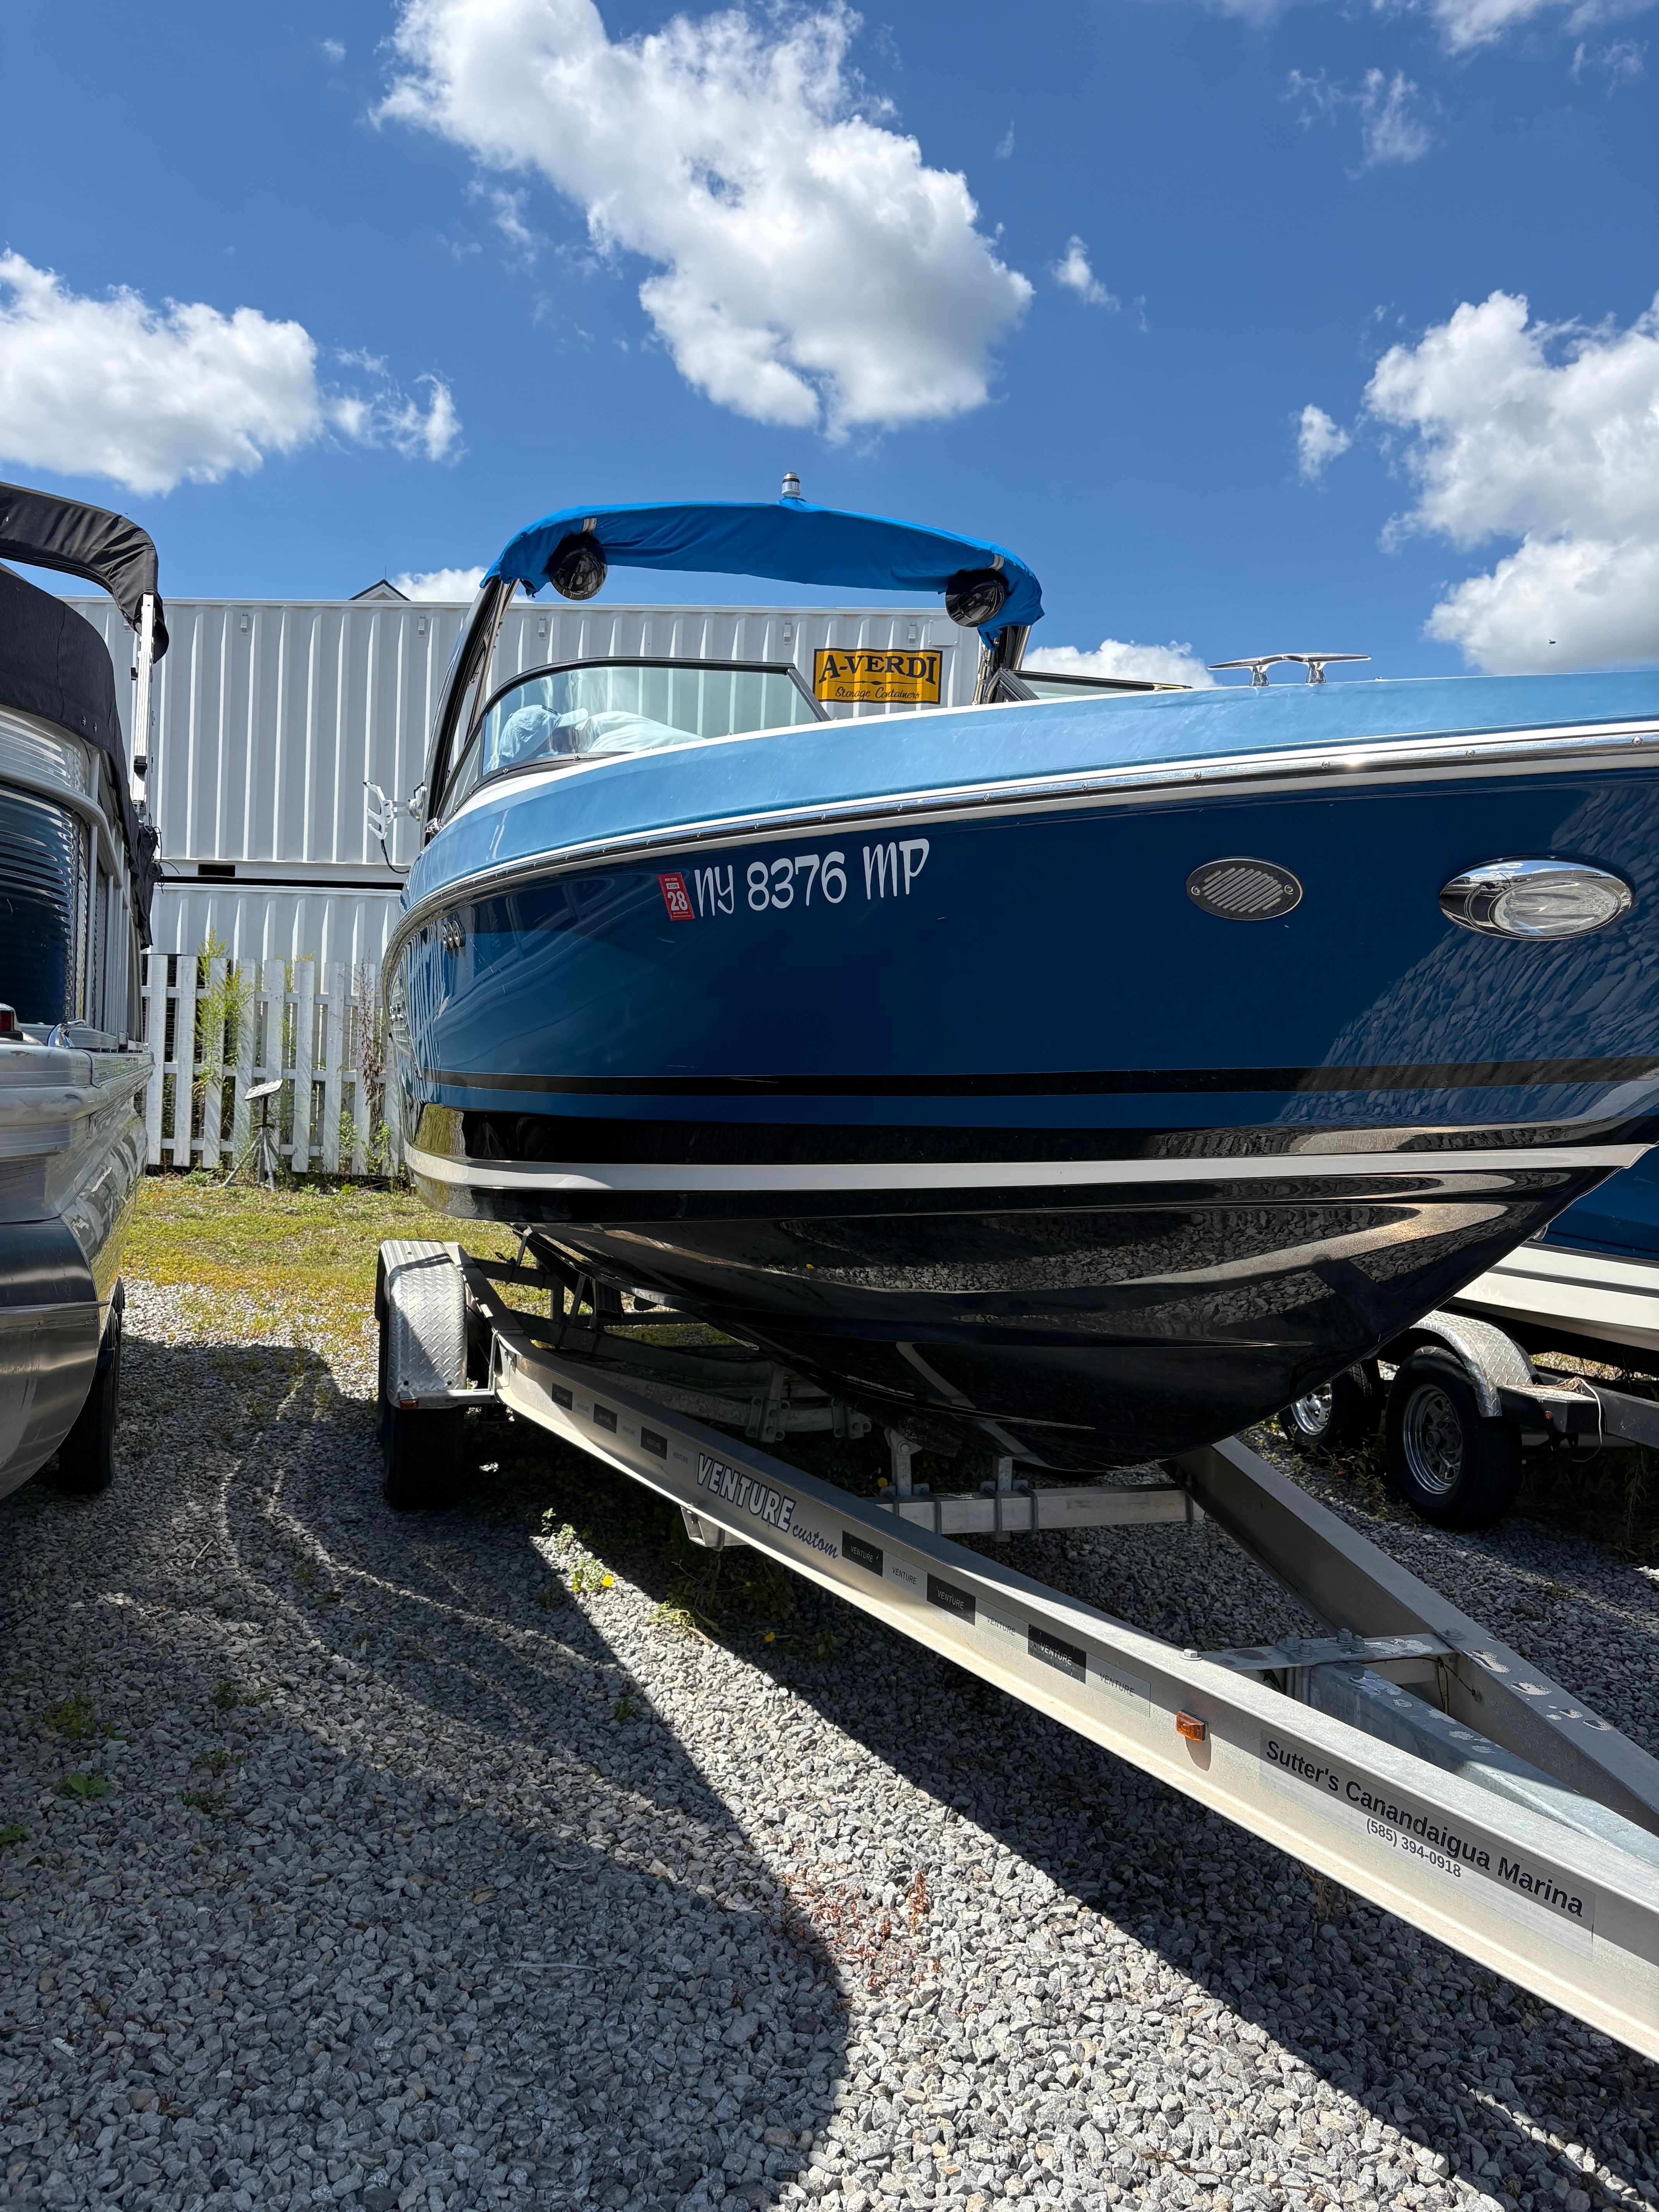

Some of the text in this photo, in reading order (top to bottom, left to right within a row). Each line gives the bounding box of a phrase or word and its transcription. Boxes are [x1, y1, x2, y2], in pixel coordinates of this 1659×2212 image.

[818, 654, 937, 685] A-VERDI
[835, 687, 921, 700] Storage Containers
[694, 838, 930, 917] NY 8376 MP
[667, 891, 688, 911] 28
[646, 1438, 661, 1450] VENTURE
[673, 1451, 689, 1464] VENTURE
[697, 1451, 839, 1559] VENTURE custom
[851, 1545, 874, 1563] VENTURE
[892, 1566, 917, 1585] VENTURE
[937, 1590, 964, 1610] VENTURE
[987, 1615, 1016, 1637] VENTURE
[1040, 1642, 1073, 1666] VENTURE
[1100, 1673, 1135, 1697] VENTURE
[1266, 1740, 1583, 1918] Sutter's Canandaigua Marina
[1366, 1818, 1462, 1878] (585) 394-0918
